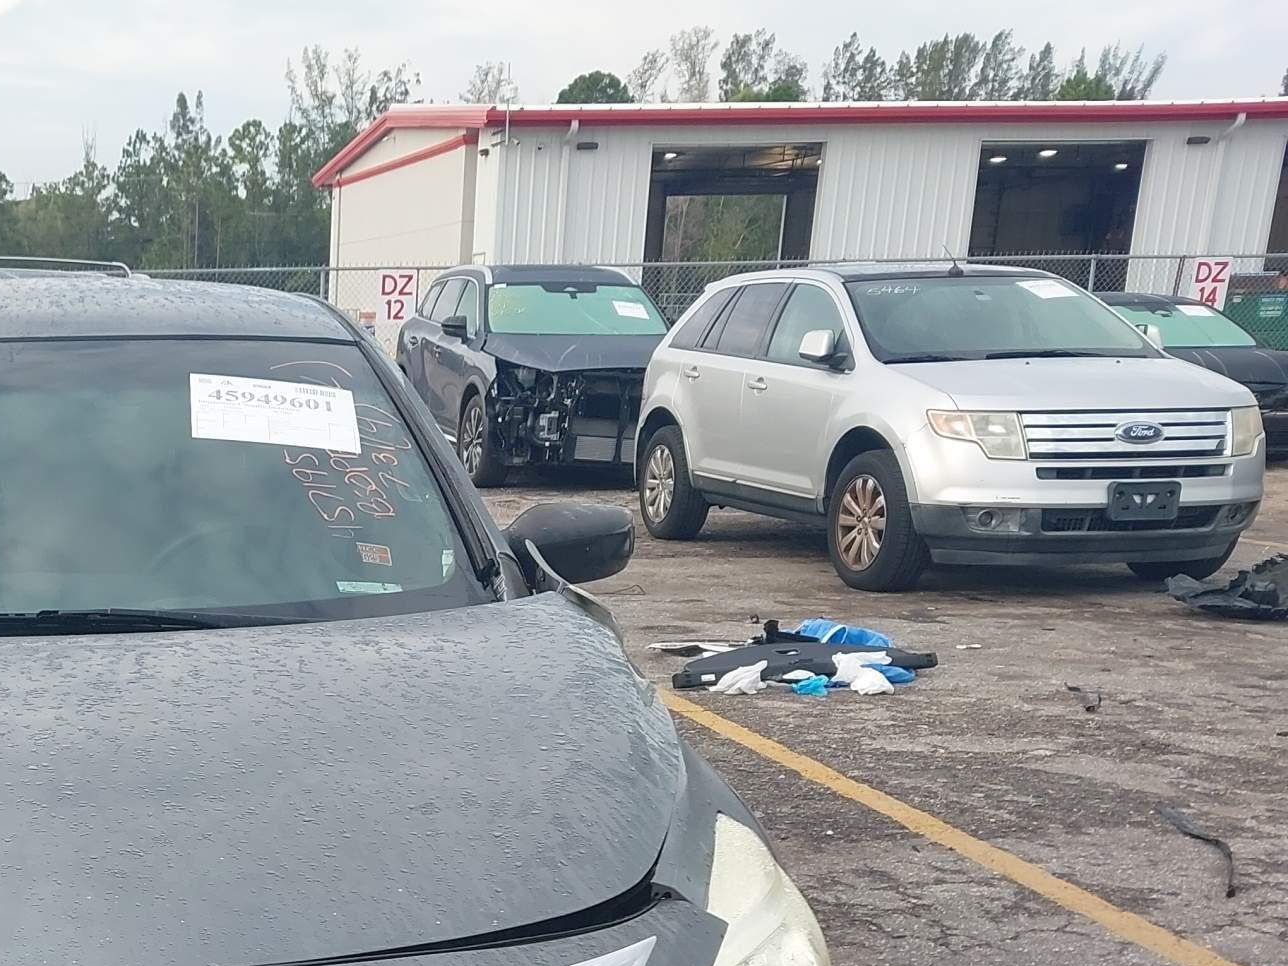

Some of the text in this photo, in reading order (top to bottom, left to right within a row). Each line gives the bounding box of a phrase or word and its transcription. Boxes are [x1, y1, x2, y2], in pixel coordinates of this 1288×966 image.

[1195, 261, 1229, 283] DZ
[381, 274, 414, 296] DZ
[1199, 286, 1218, 306] 14
[385, 299, 404, 320] 12
[208, 388, 333, 412] 45949601
[1130, 425, 1155, 436] Ford
